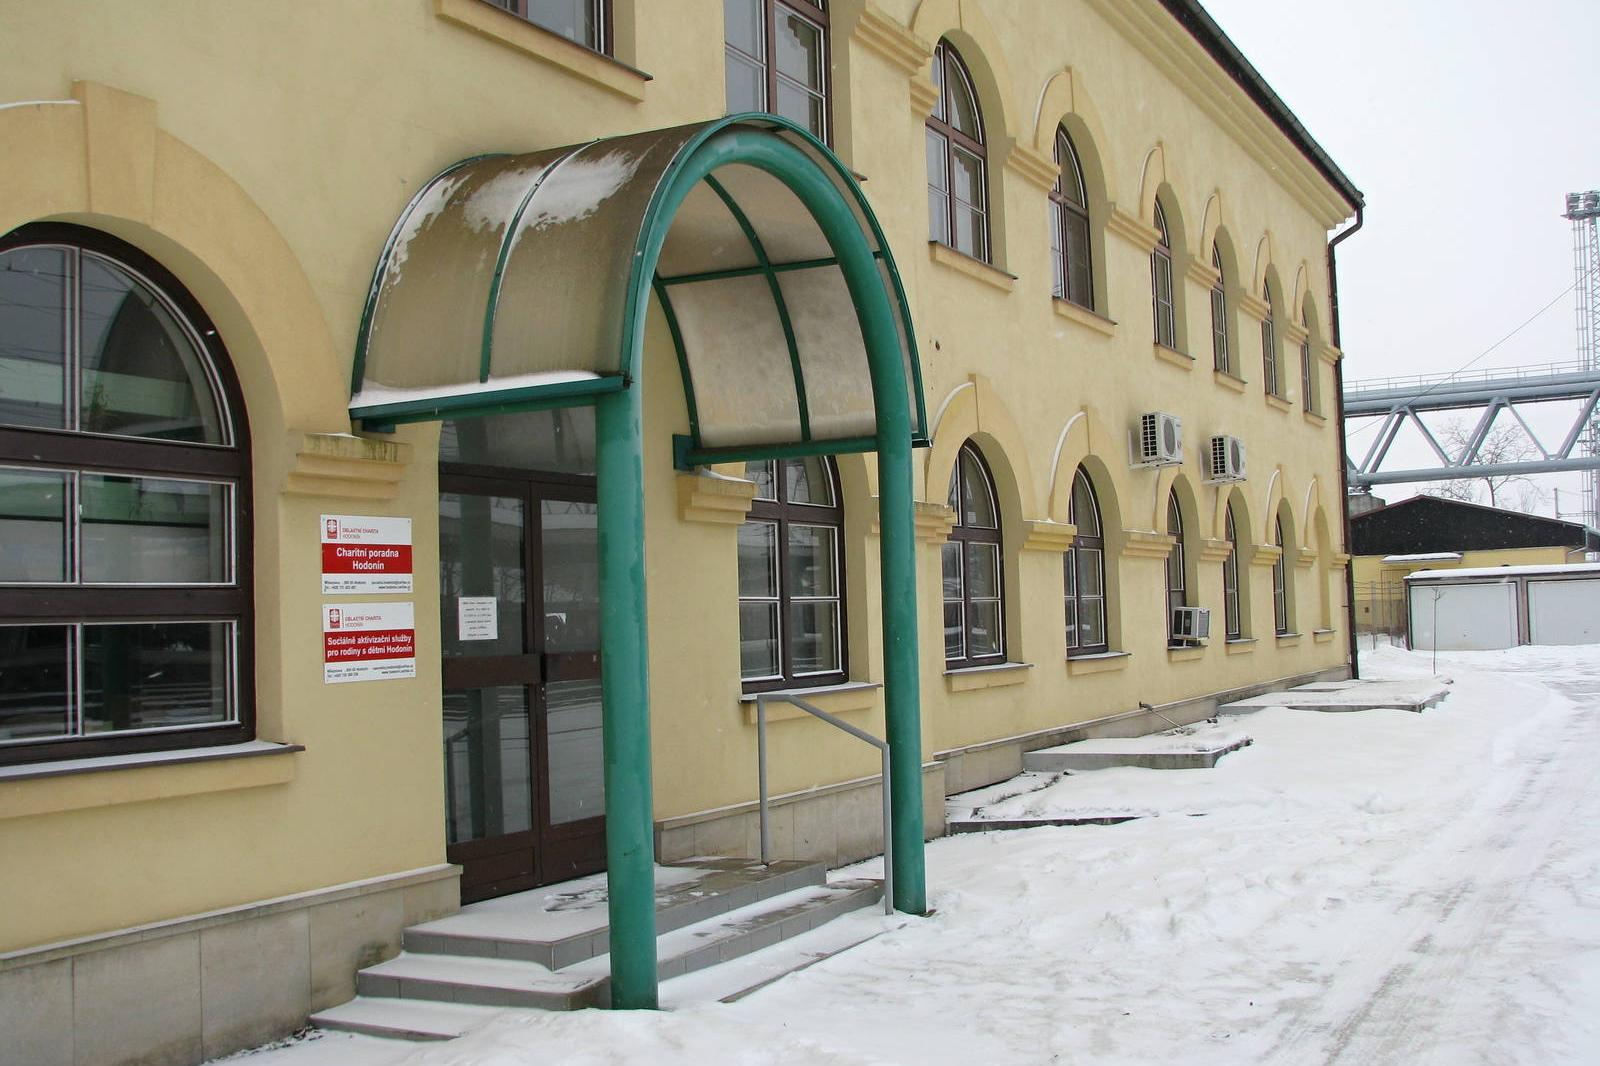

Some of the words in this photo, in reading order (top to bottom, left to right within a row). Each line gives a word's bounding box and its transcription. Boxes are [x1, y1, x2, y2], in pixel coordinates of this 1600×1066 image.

[368, 549, 399, 559] poradna
[357, 634, 391, 644] aktivizační
[391, 634, 412, 644] služby
[327, 649, 339, 658] pro
[340, 647, 361, 657] rodiny
[368, 646, 385, 655] dětmi
